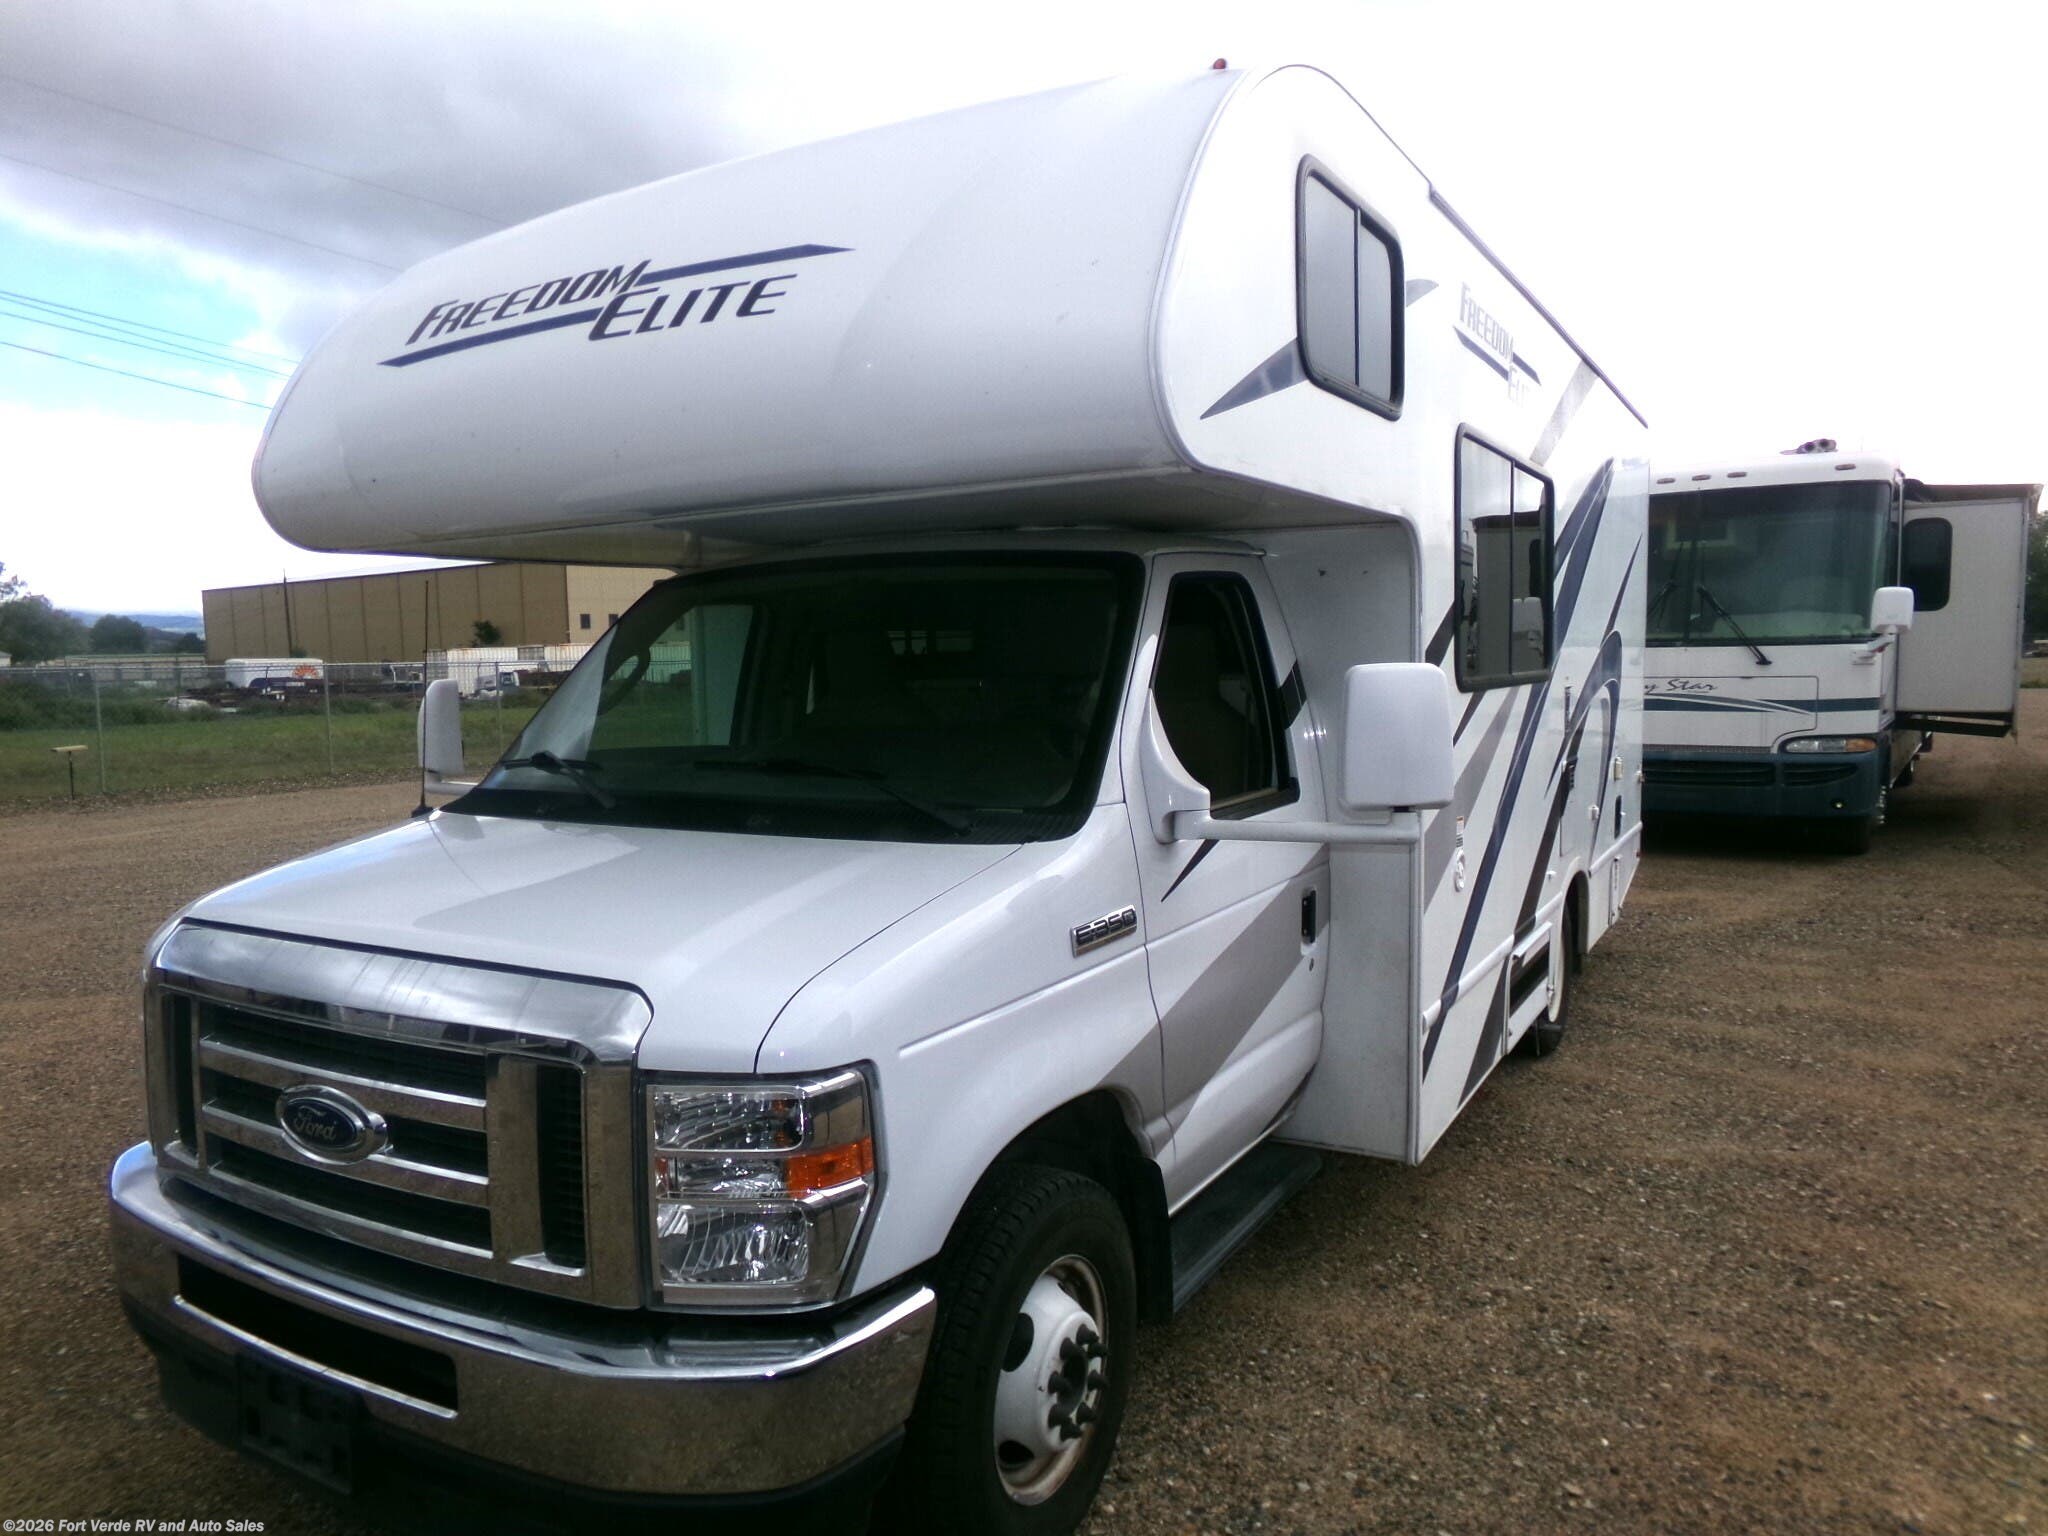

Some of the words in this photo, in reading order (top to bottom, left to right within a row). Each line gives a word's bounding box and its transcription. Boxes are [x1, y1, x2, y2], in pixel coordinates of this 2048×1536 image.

[405, 258, 652, 346] FREEDOM
[588, 273, 798, 341] ELITE
[1459, 281, 1514, 364] FREEDOM
[1665, 678, 1718, 691] Star
[293, 1105, 337, 1140] Ford
